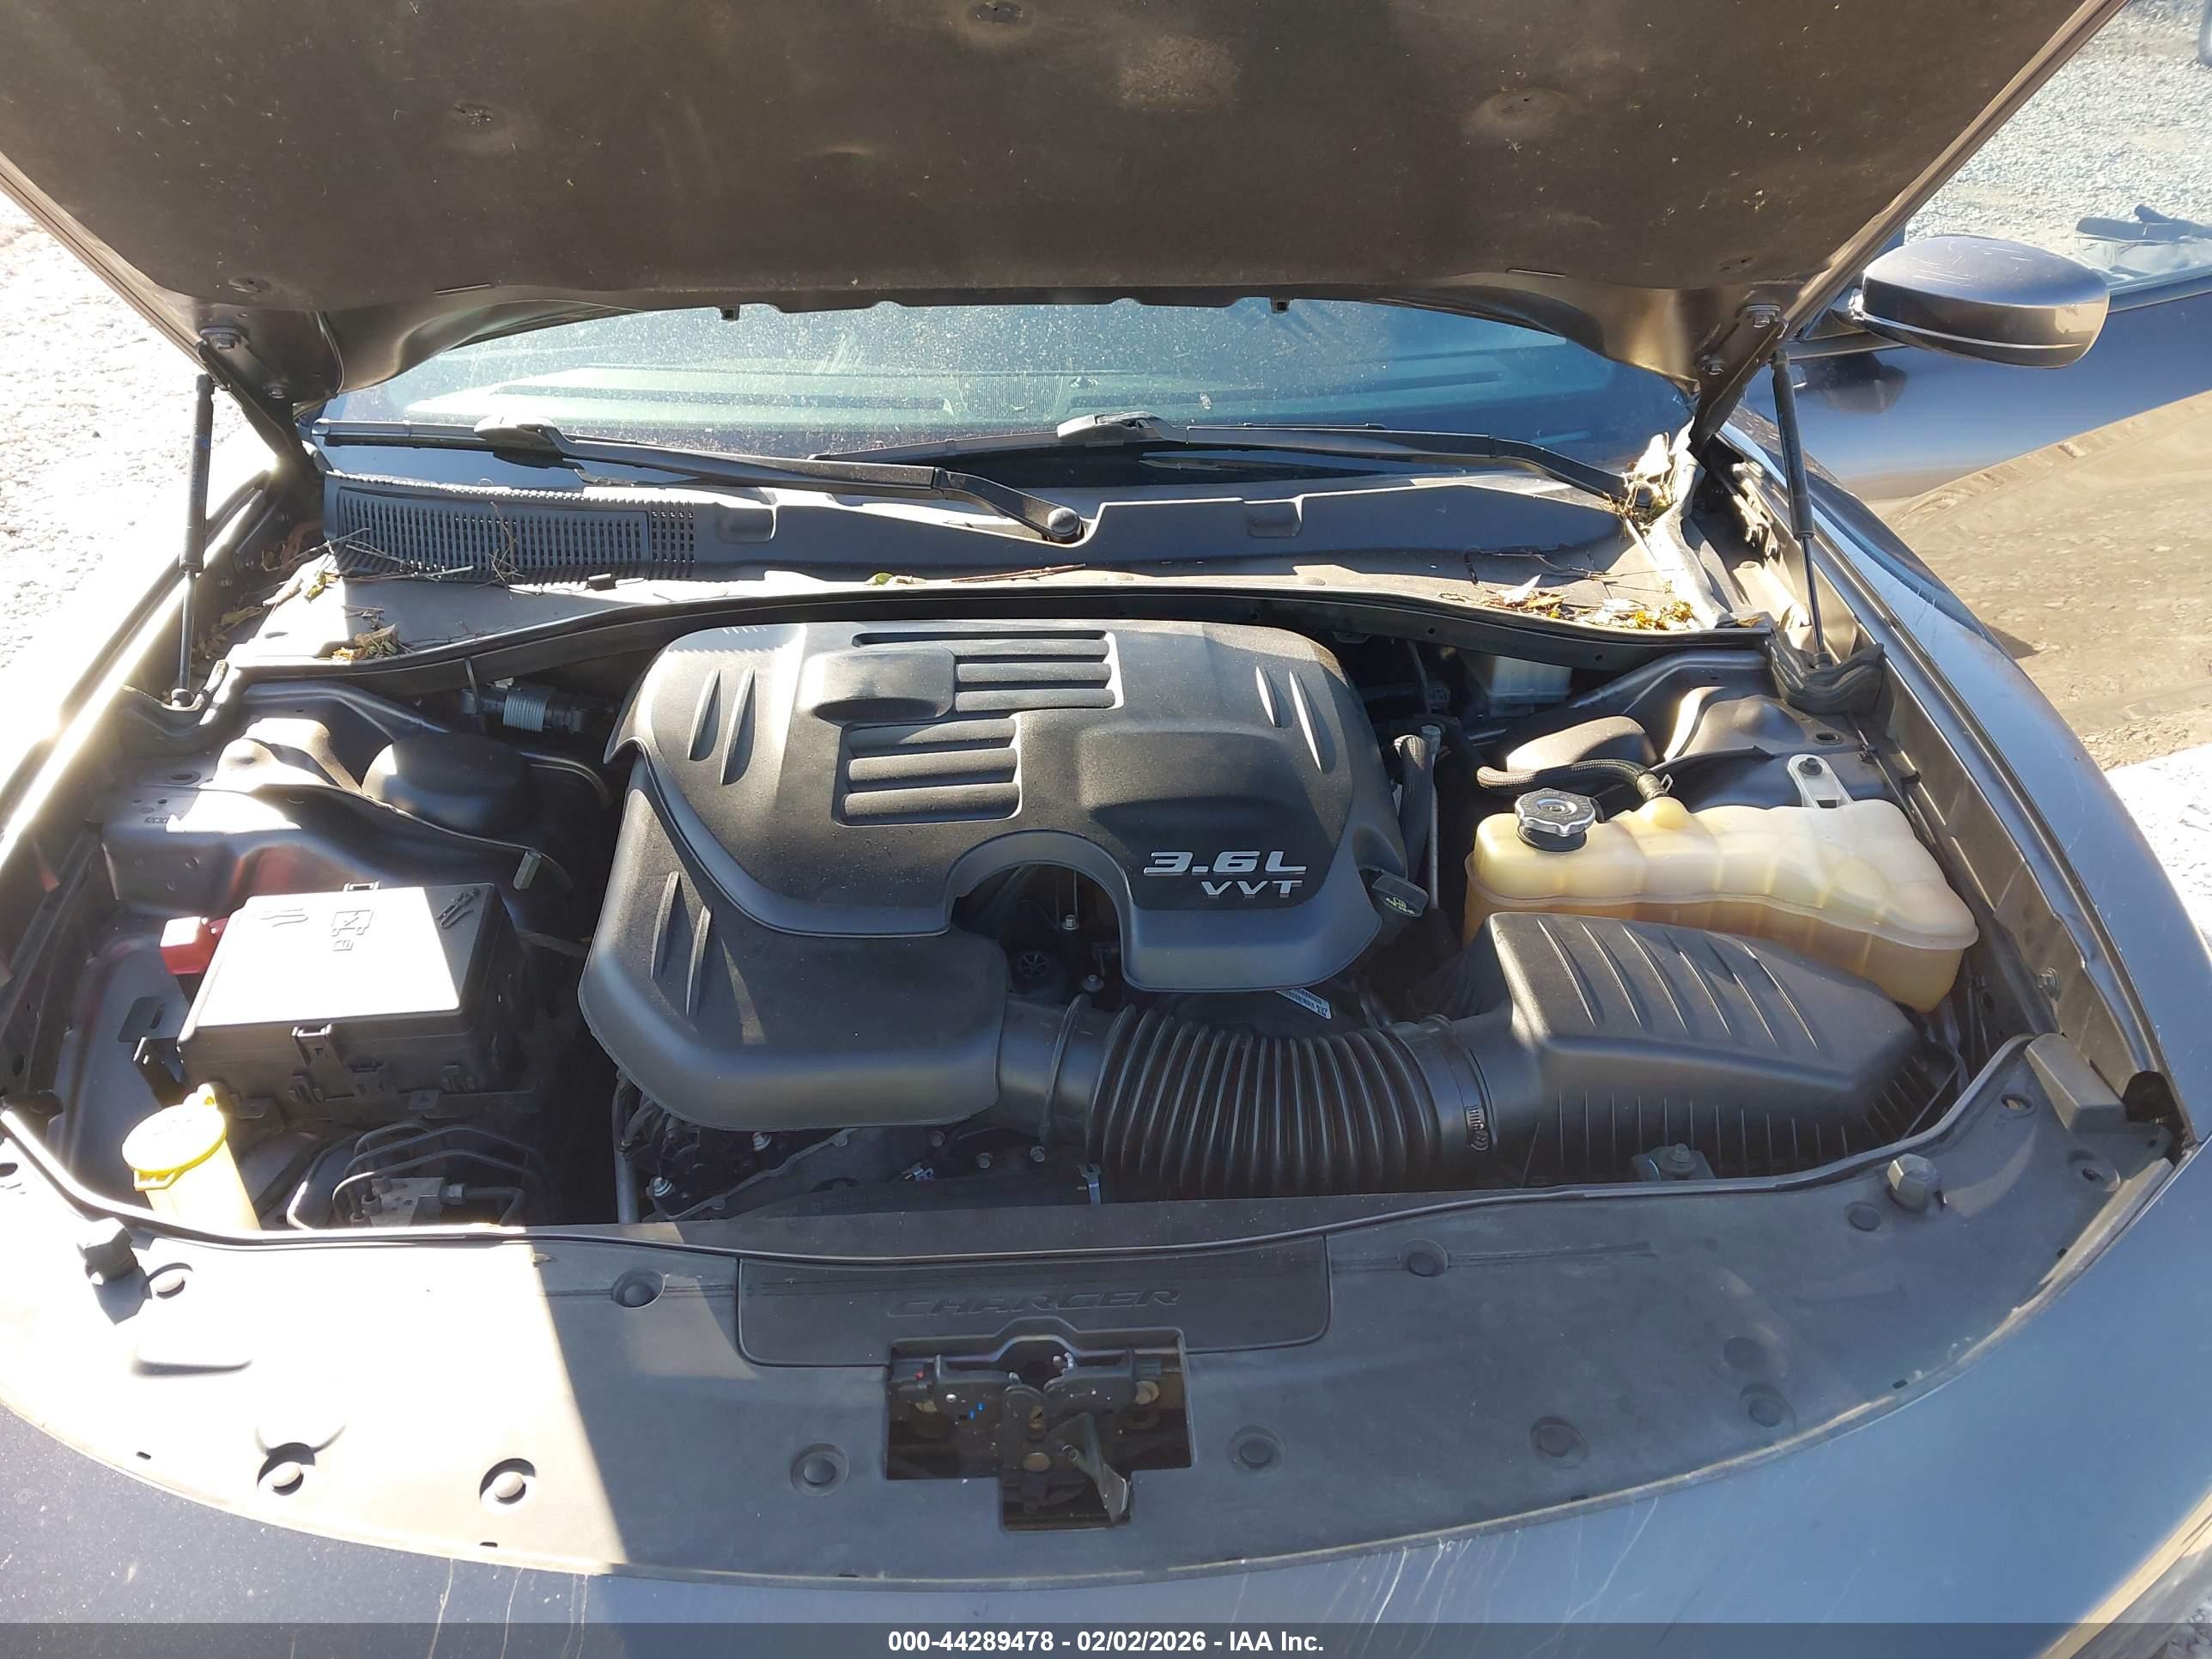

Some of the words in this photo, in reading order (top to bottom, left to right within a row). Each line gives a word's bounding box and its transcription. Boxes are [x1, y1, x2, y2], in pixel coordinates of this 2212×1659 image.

[1144, 851, 1307, 876] 3.6L
[1201, 880, 1303, 898] VVT
[886, 1289, 1181, 1318] CHARGER
